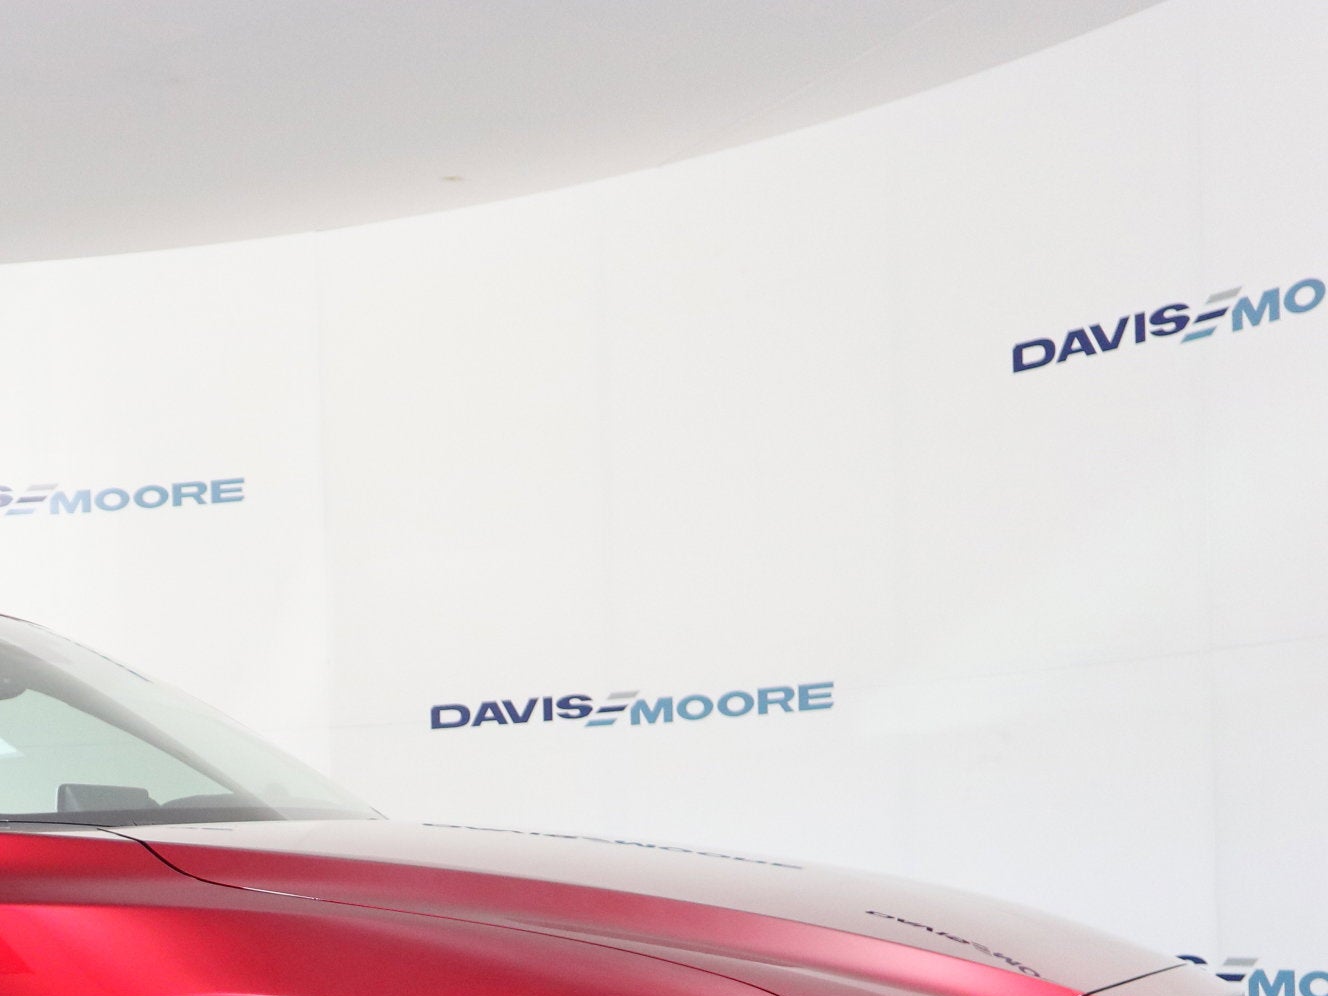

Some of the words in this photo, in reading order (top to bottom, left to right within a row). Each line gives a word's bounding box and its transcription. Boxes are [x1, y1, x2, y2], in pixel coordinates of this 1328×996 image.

[1012, 302, 1191, 374] DAVIS
[49, 476, 245, 516] MOORE
[430, 693, 593, 730] DAVIS
[629, 680, 835, 726] MOORE
